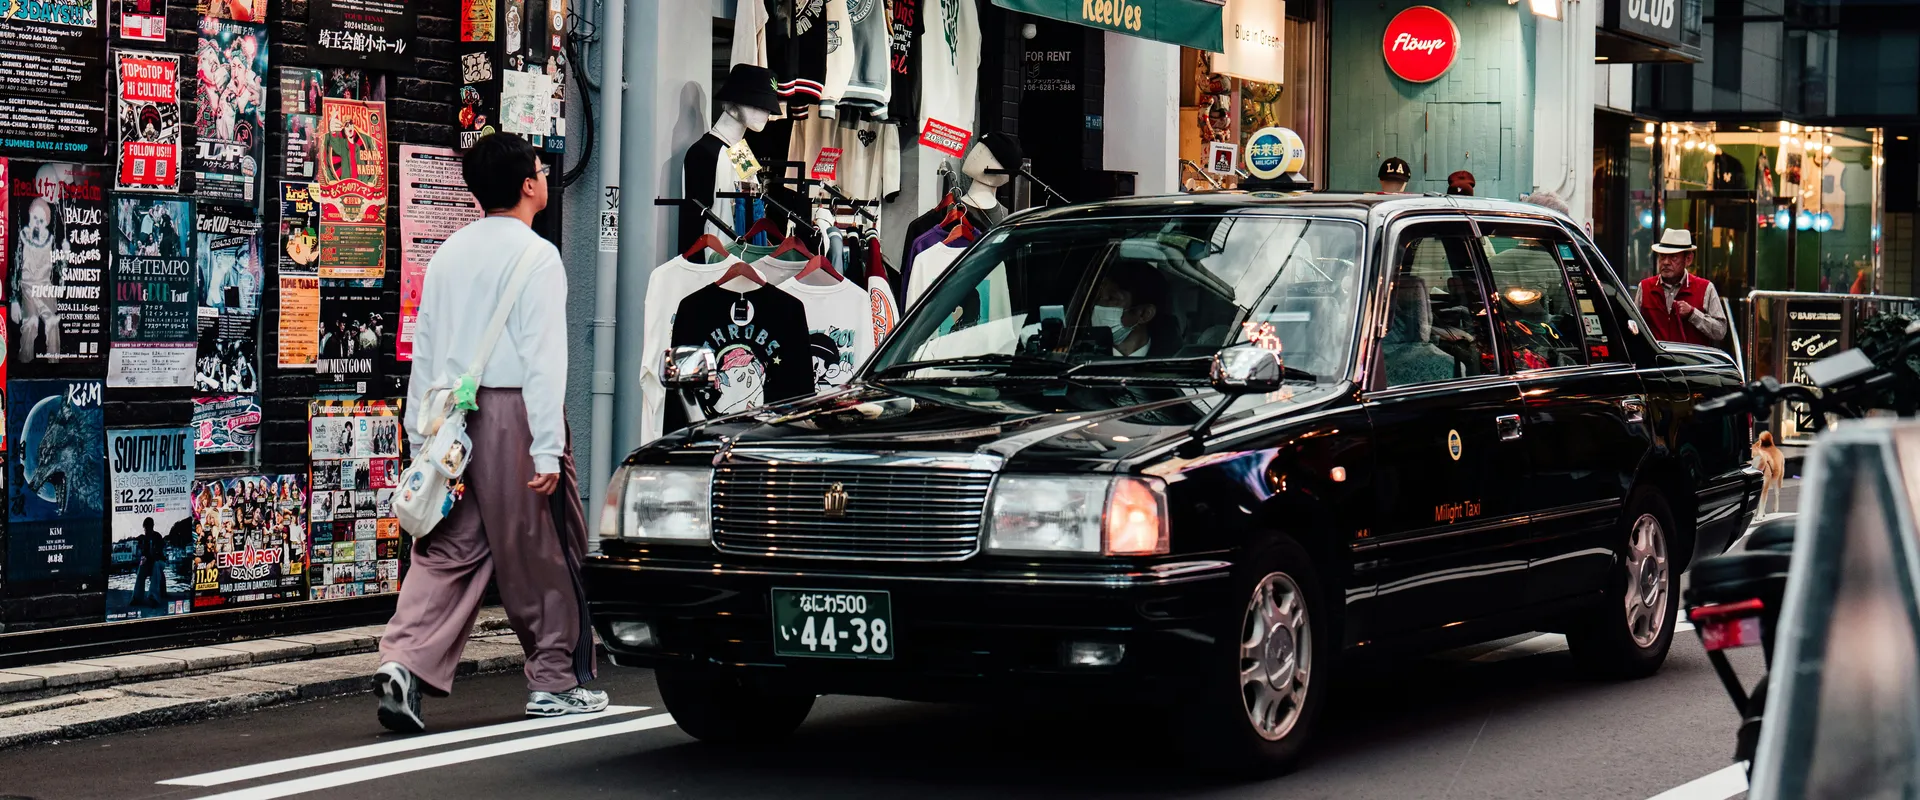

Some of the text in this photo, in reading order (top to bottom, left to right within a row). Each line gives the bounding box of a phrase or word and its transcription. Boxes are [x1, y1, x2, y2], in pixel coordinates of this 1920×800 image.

[318, 29, 407, 54] 埼玉会館小ホール
[1235, 24, 1250, 42] Blue
[1260, 29, 1280, 48] Green
[1025, 51, 1072, 62] FOR RENT
[164, 67, 174, 83] by
[127, 81, 172, 98] Hi CULTURE
[5, 139, 35, 149] SUMMER
[36, 141, 54, 150] DAYZ
[55, 142, 63, 150] AT
[64, 144, 89, 152] STOMP
[129, 144, 172, 158] FOLLOW US!!!
[1250, 143, 1285, 157] 未来都
[13, 177, 101, 202] Reality Freedom
[64, 205, 102, 226] BALZAC
[212, 216, 229, 233] KID
[61, 268, 101, 282] SANDIEST
[66, 285, 101, 299] JUNKIES
[84, 313, 100, 321] SHIGA
[330, 359, 349, 373] MUST
[348, 359, 359, 373] GO
[360, 358, 372, 373] ON
[67, 382, 101, 406] KiM
[115, 434, 187, 473] SOUTH BLUE
[342, 460, 354, 468] GLAY
[115, 472, 187, 489] 1st OneMan Live
[120, 488, 154, 504] 12.22
[159, 486, 186, 495] SUNHALL
[134, 504, 153, 514] 3,000
[1435, 499, 1481, 524] Milight Taxi
[196, 569, 218, 583] 11.09
[231, 565, 270, 580] DANCE
[781, 616, 888, 654] い 44-38
